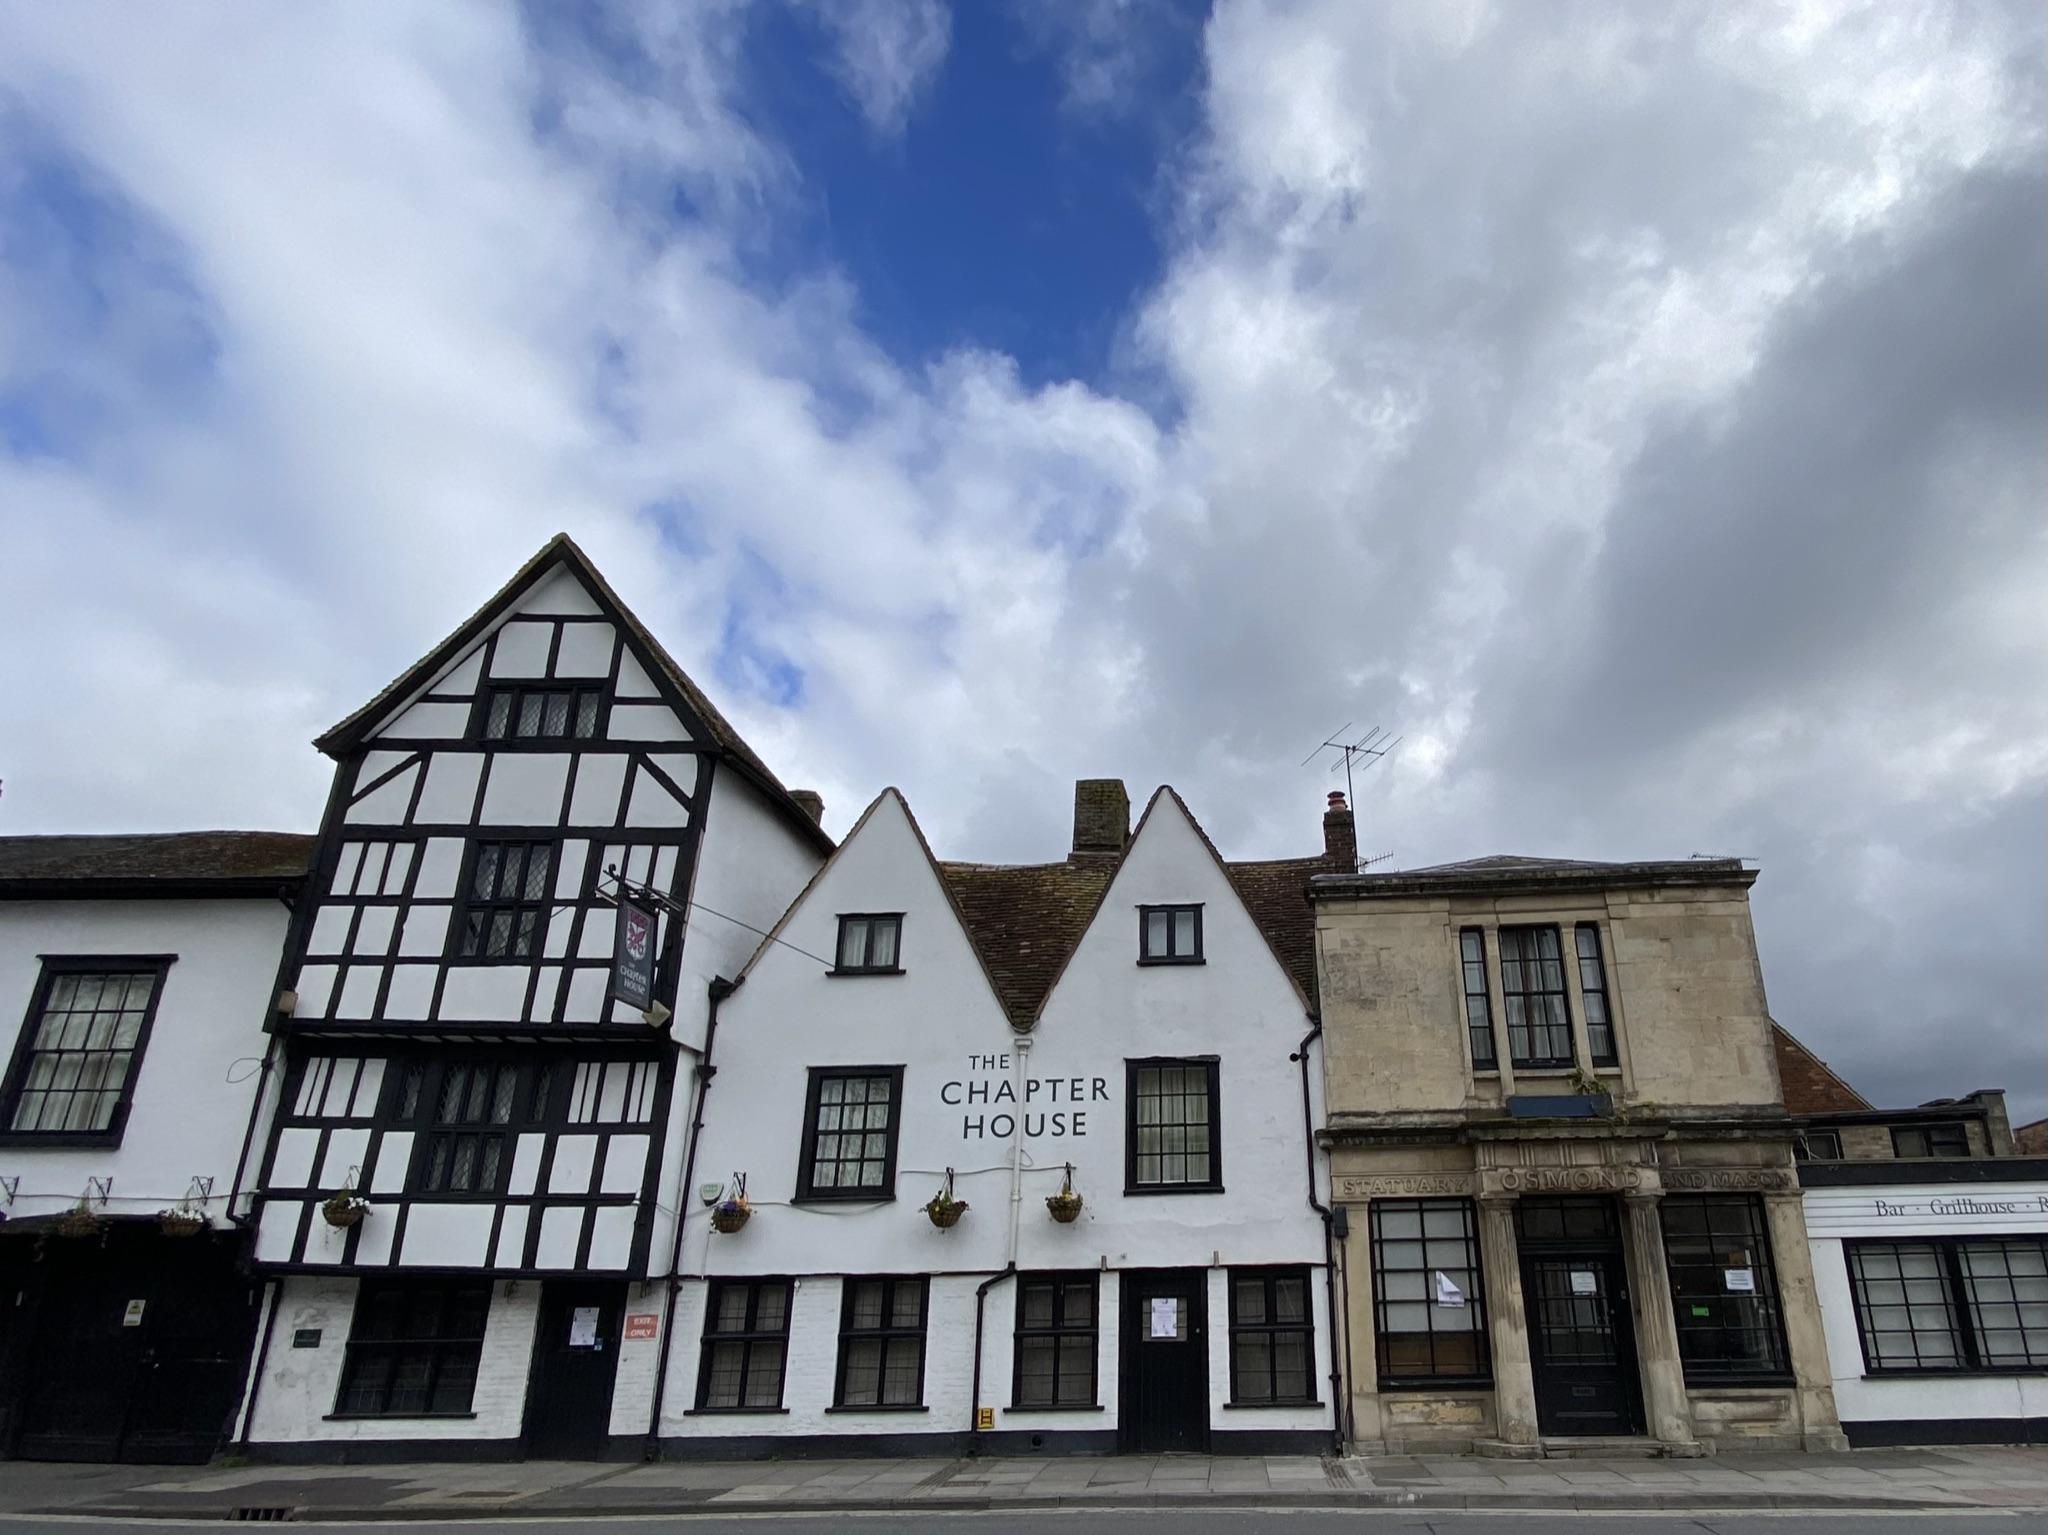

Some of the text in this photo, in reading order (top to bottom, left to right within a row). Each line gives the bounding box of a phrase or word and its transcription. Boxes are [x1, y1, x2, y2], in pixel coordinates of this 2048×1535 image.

[968, 1053, 1010, 1070] THE
[940, 1077, 1110, 1105] CHAPTER
[962, 1112, 1087, 1139] HOUSE
[1344, 1177, 1468, 1196] STATUARY
[1502, 1169, 1642, 1190] OSMOND
[1660, 1171, 1707, 1189] AND
[1875, 1200, 1905, 1216] Bar
[1930, 1198, 2015, 1215] Grillhouse
[633, 1317, 651, 1325] EXIT
[630, 1329, 651, 1337] ONLY
